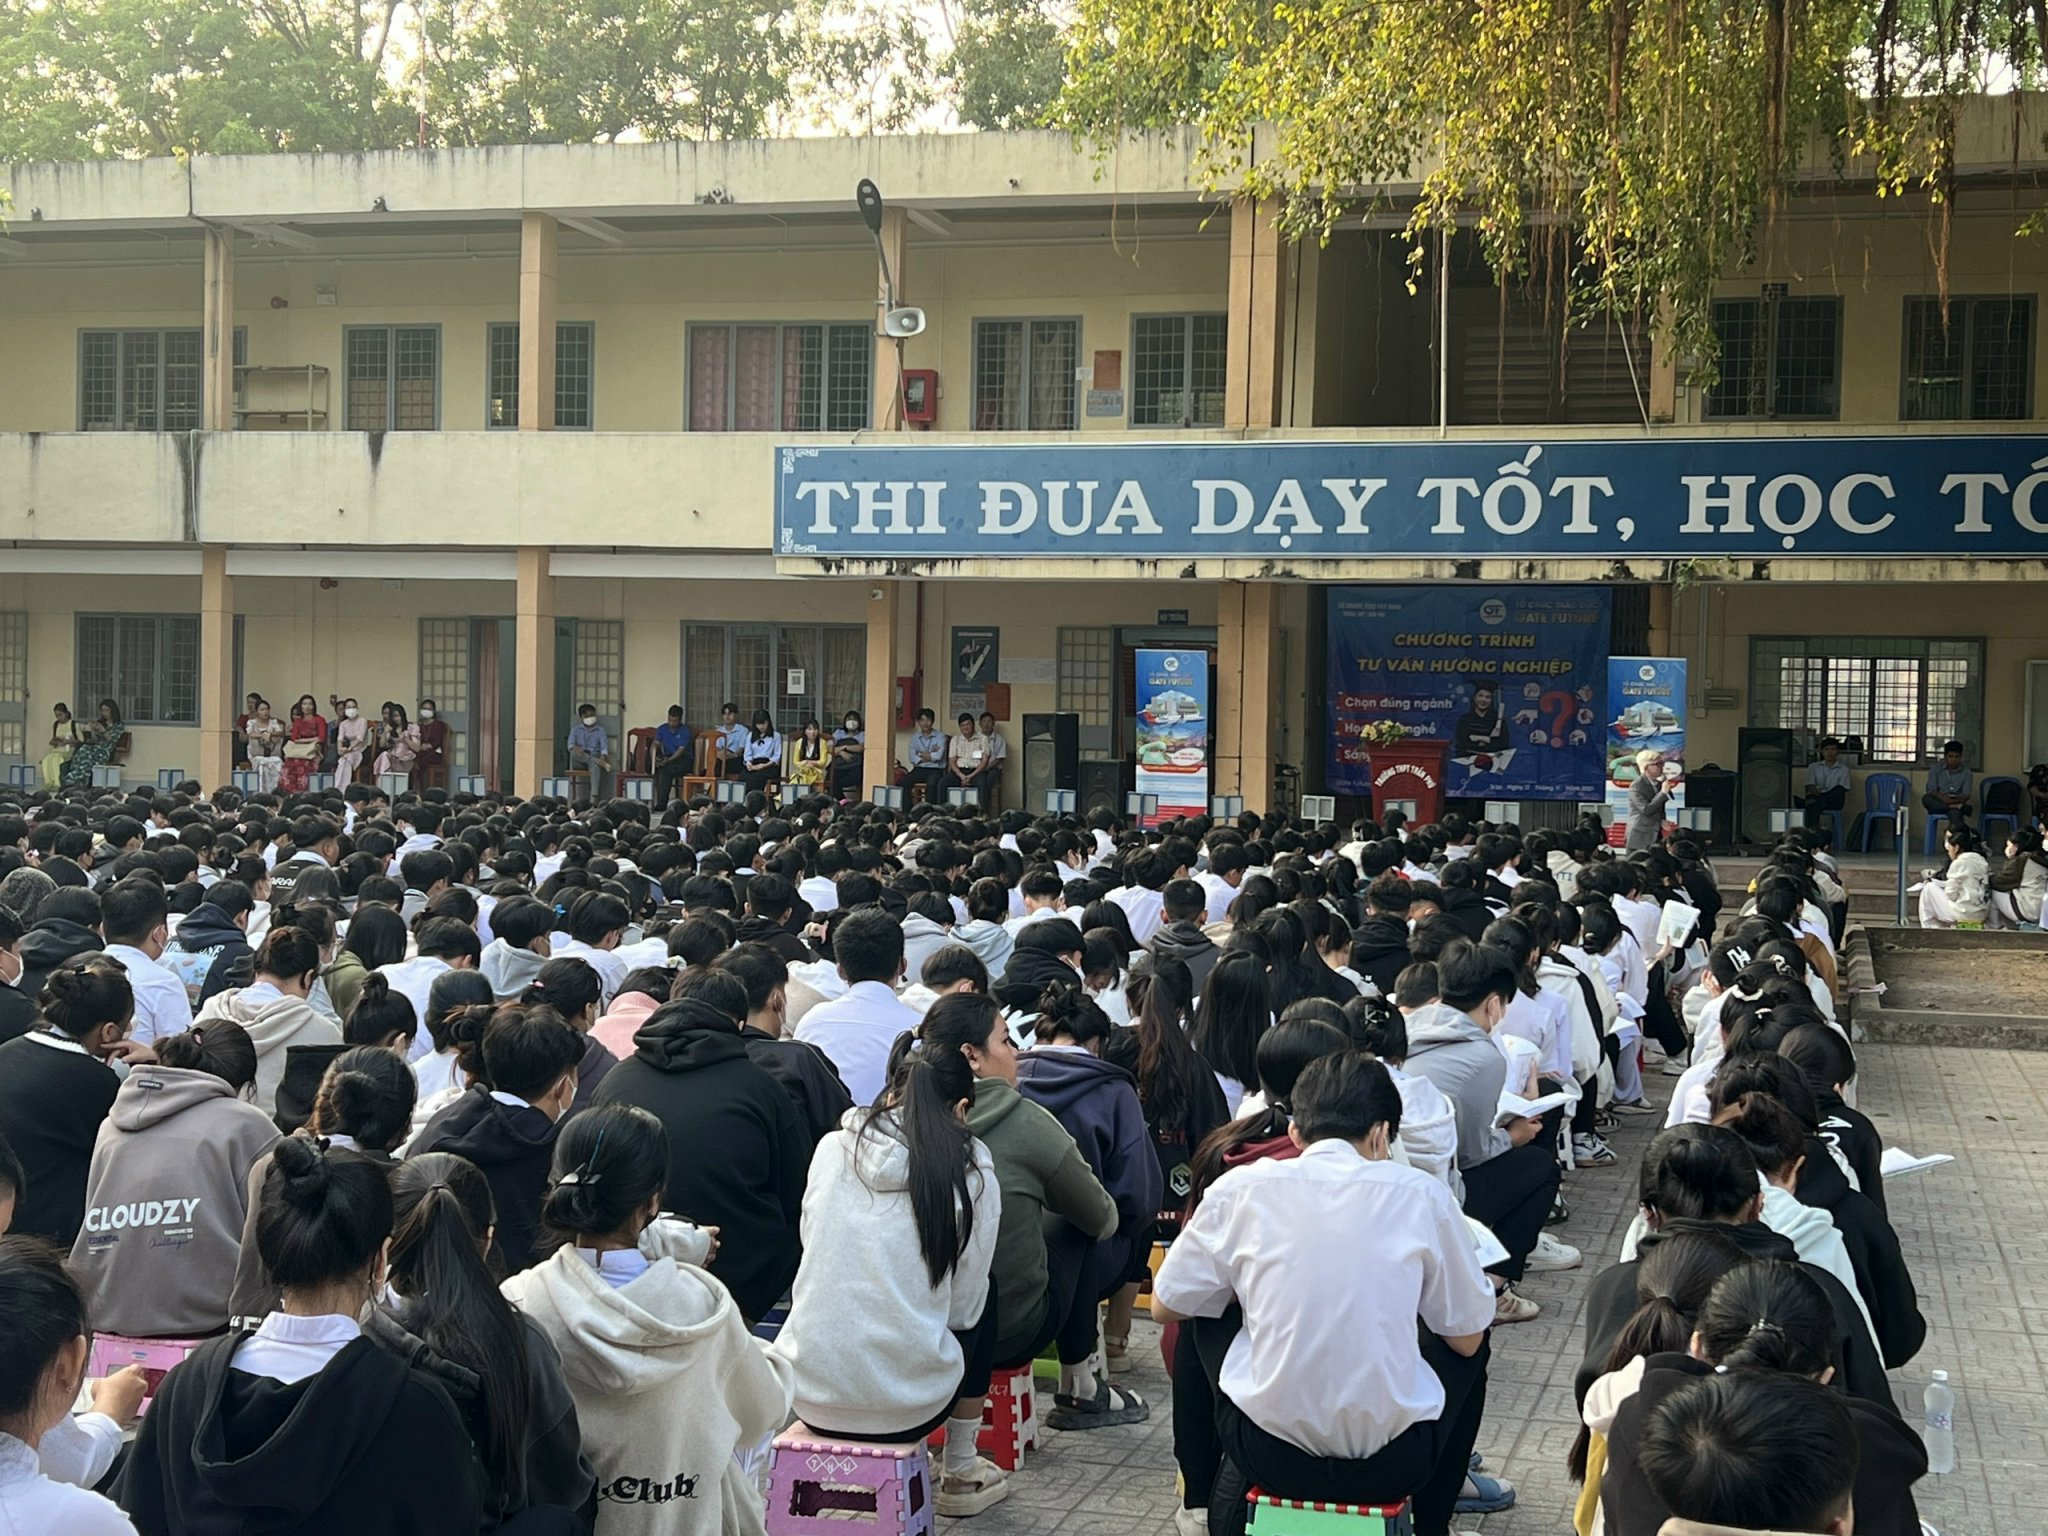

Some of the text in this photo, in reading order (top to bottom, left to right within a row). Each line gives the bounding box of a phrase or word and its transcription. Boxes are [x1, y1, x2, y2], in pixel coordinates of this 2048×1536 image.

[794, 479, 947, 536] THI
[977, 479, 1163, 536] ĐUA
[1190, 478, 1389, 550] DẠY
[1416, 444, 1636, 544] TỐT,
[1679, 472, 1896, 550] HỌC
[1479, 631, 1536, 648] TRÌNH
[1357, 657, 1385, 672] TƯ
[1502, 659, 1574, 679] NGHIỆP
[1344, 697, 1376, 710] Chọn
[1380, 697, 1411, 711] đúng
[85, 1197, 201, 1233] CLOUDZY
